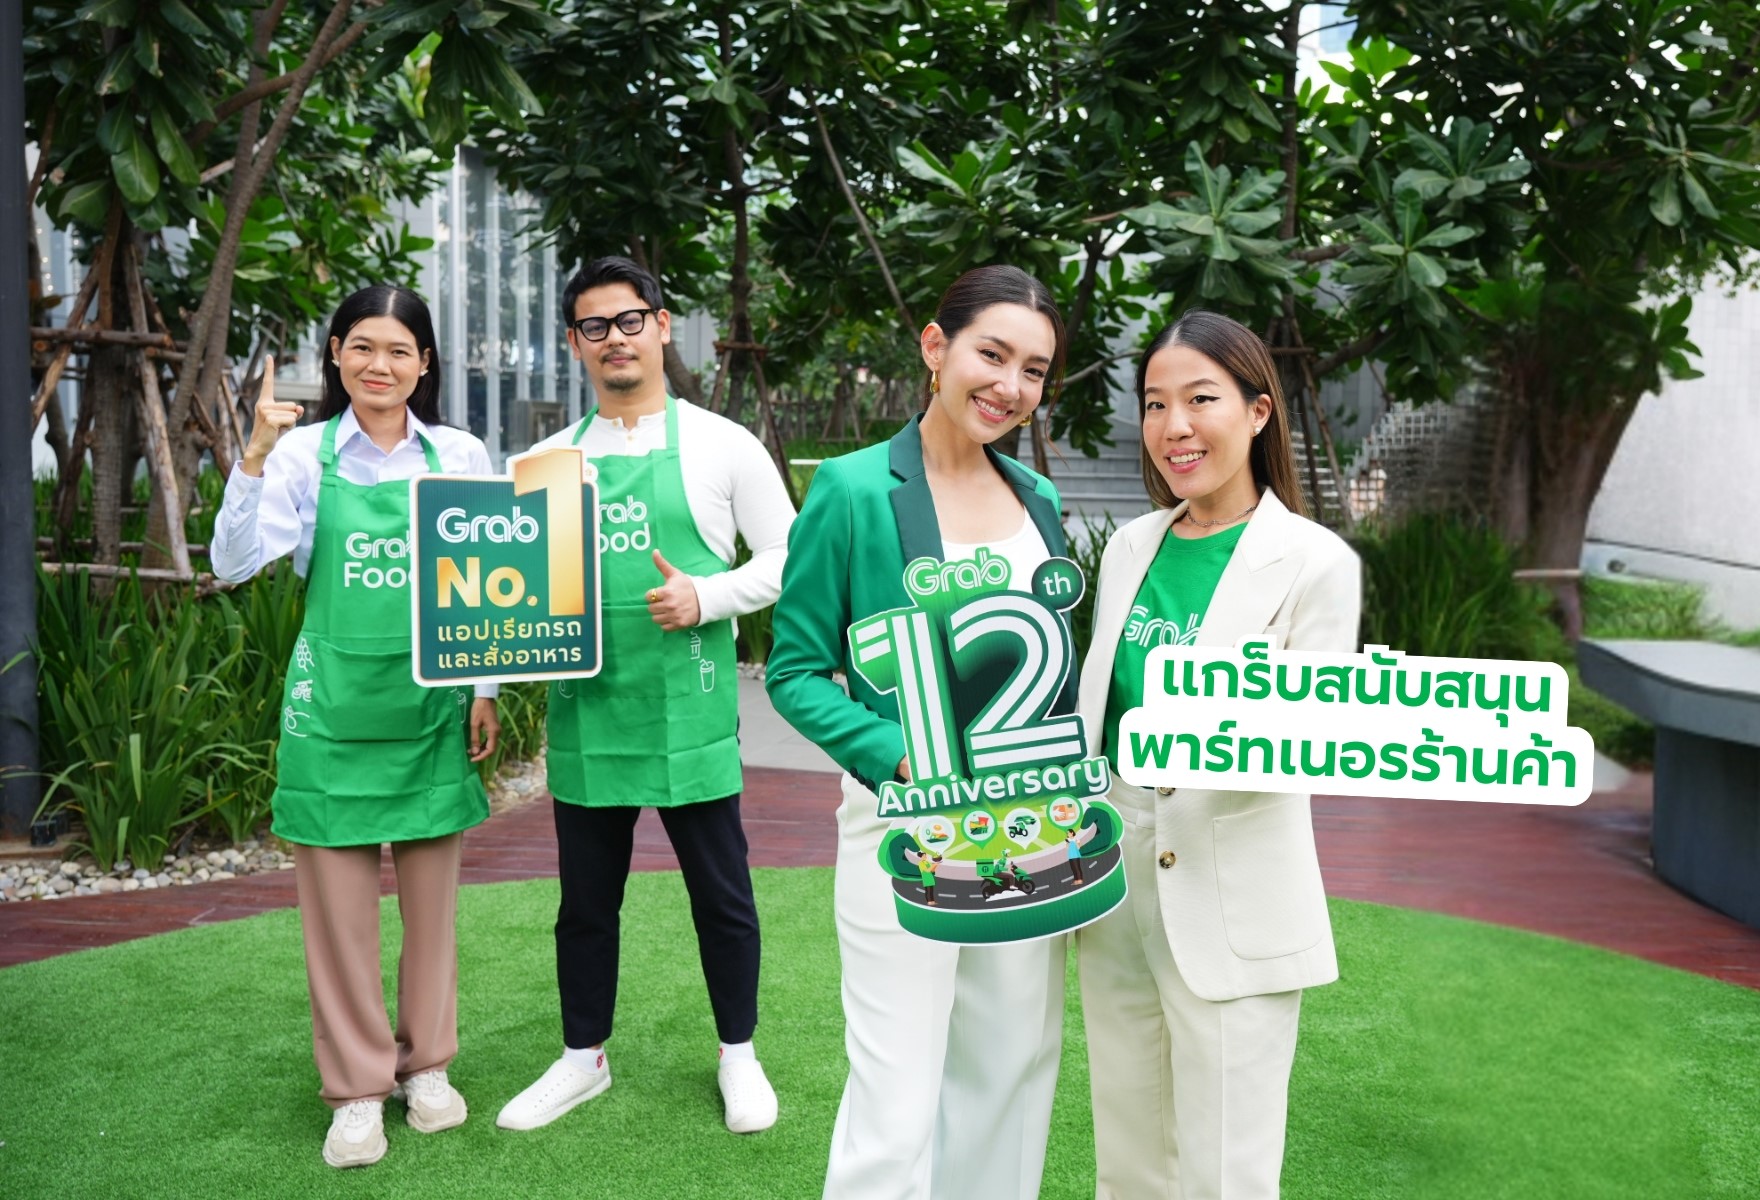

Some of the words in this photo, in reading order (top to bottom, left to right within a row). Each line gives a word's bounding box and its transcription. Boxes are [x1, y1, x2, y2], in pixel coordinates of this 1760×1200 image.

[599, 494, 647, 524] rab
[436, 505, 540, 544] Grab
[344, 561, 411, 589] Foo
[908, 549, 1009, 596] Grab
[438, 617, 582, 642] แอปเรียกรถ
[438, 641, 582, 669] และสั่งอาหาร
[879, 759, 1108, 815] Anniversary
